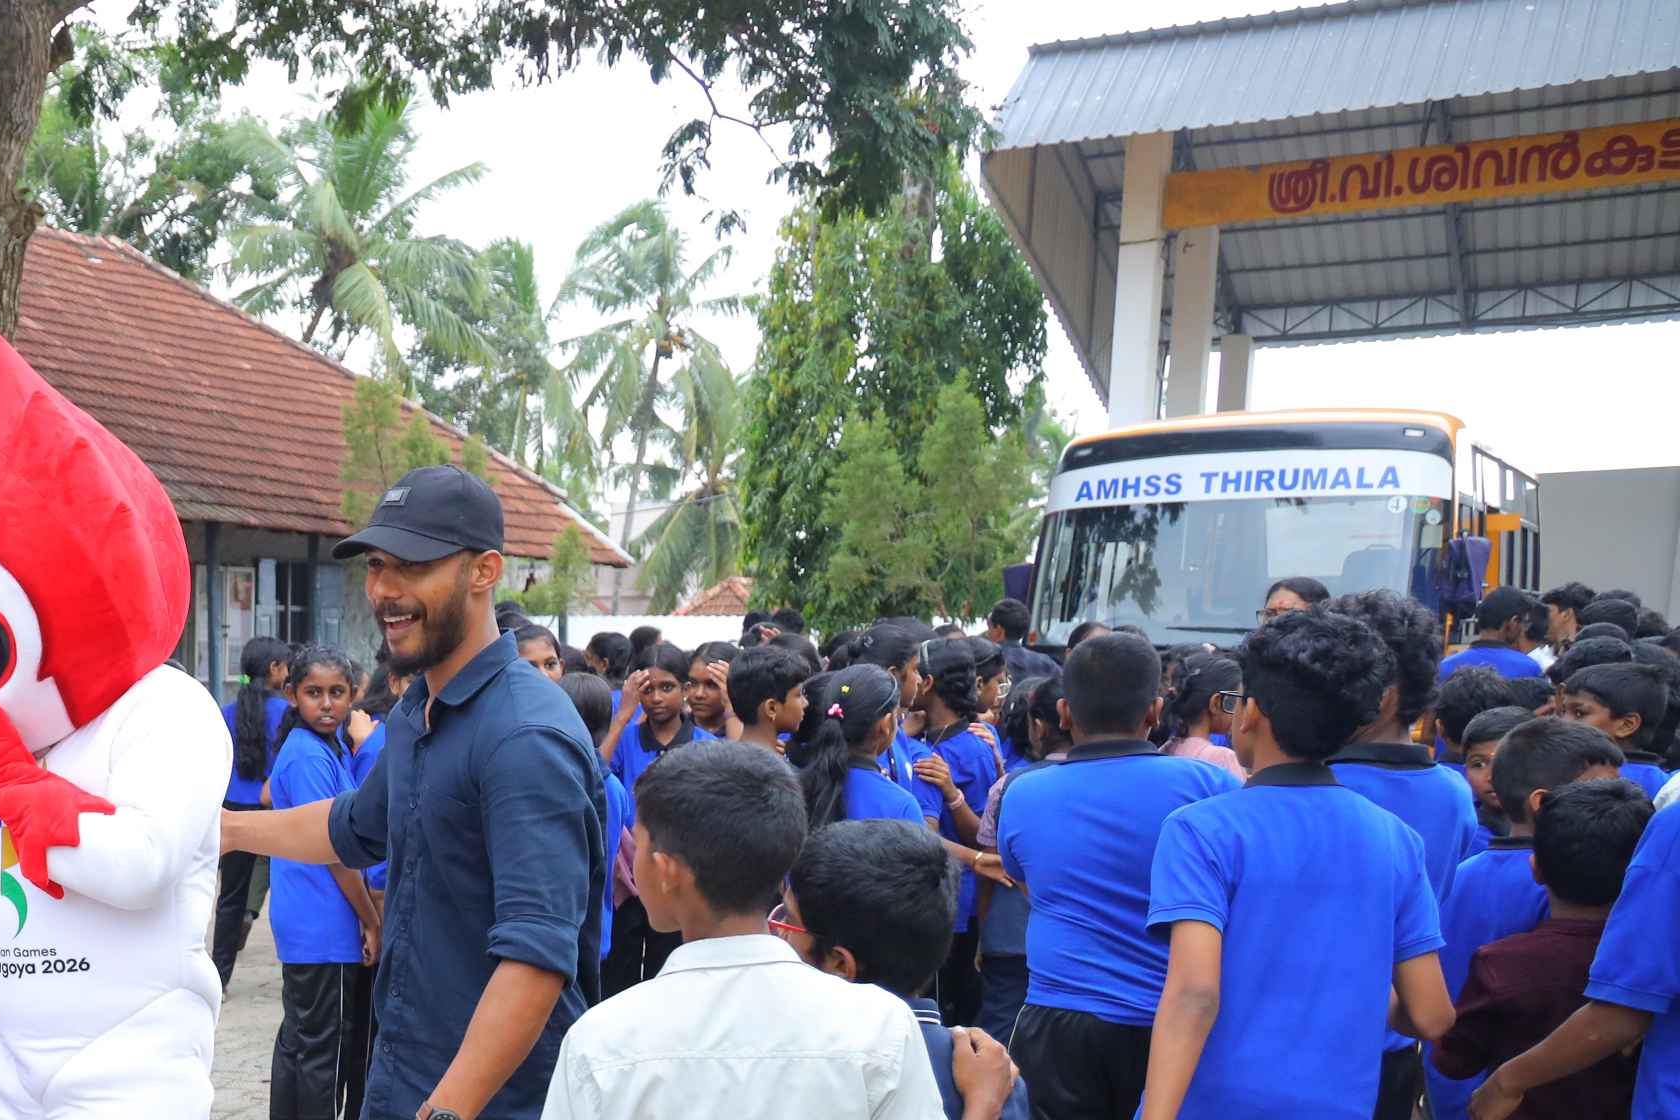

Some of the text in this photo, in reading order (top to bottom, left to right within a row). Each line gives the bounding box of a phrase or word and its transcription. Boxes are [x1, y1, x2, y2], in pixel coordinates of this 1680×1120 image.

[1075, 465, 1401, 501] AMHSS THIRUMALA
[13, 947, 57, 958] Games
[41, 957, 91, 974] 2026
